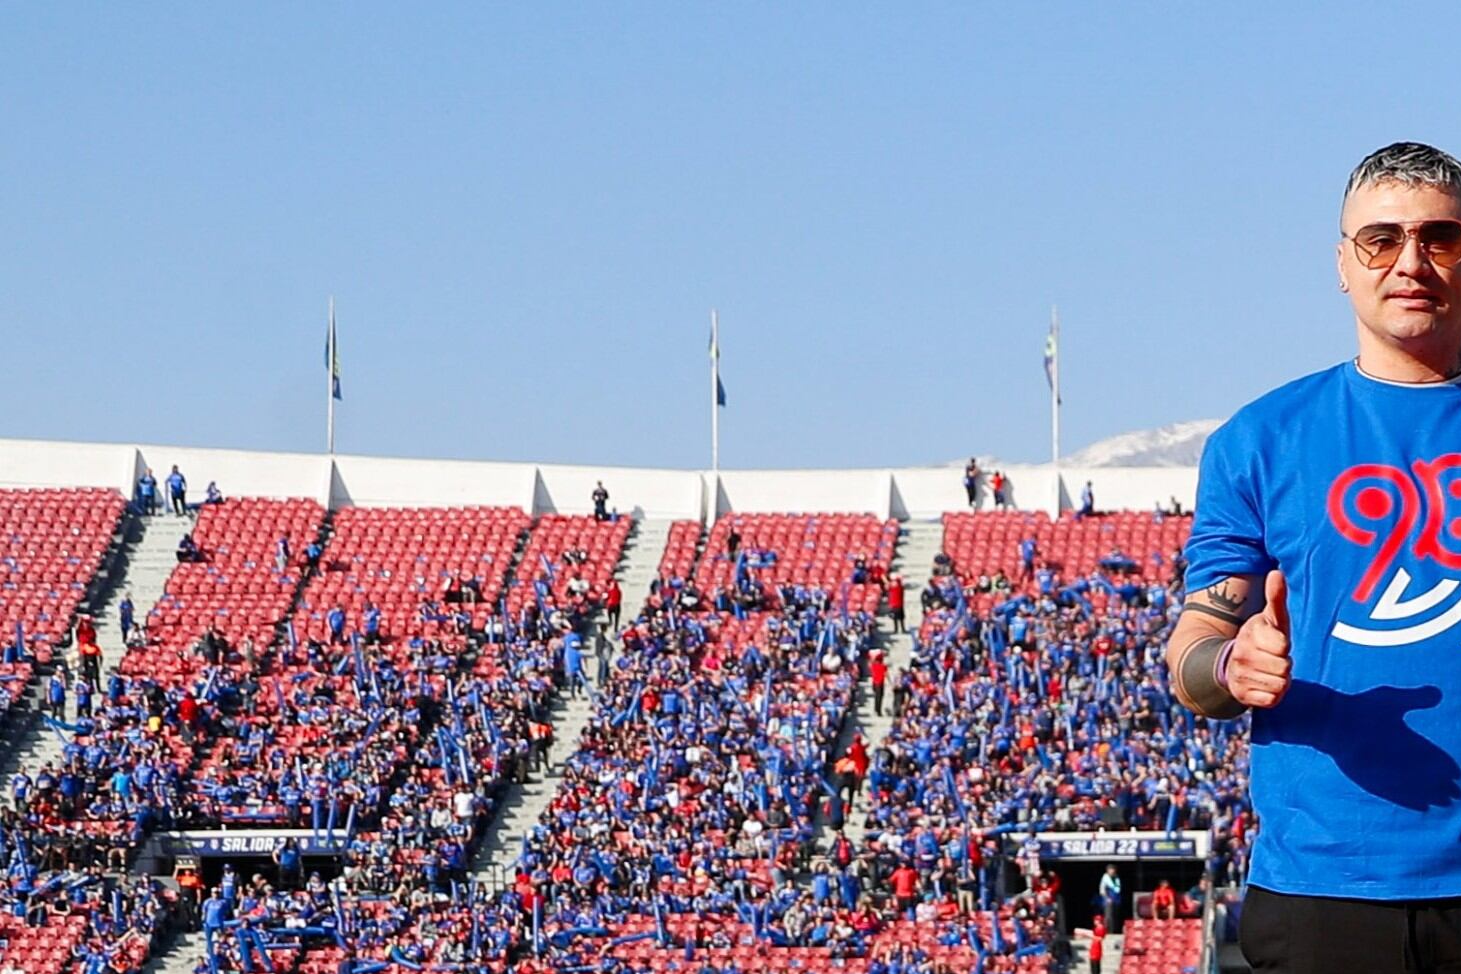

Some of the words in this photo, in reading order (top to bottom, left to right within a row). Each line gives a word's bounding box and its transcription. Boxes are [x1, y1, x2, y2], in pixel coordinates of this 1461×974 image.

[221, 837, 274, 851] SALIDA
[1062, 840, 1115, 854] SALIDA
[1116, 839, 1138, 854] 22
